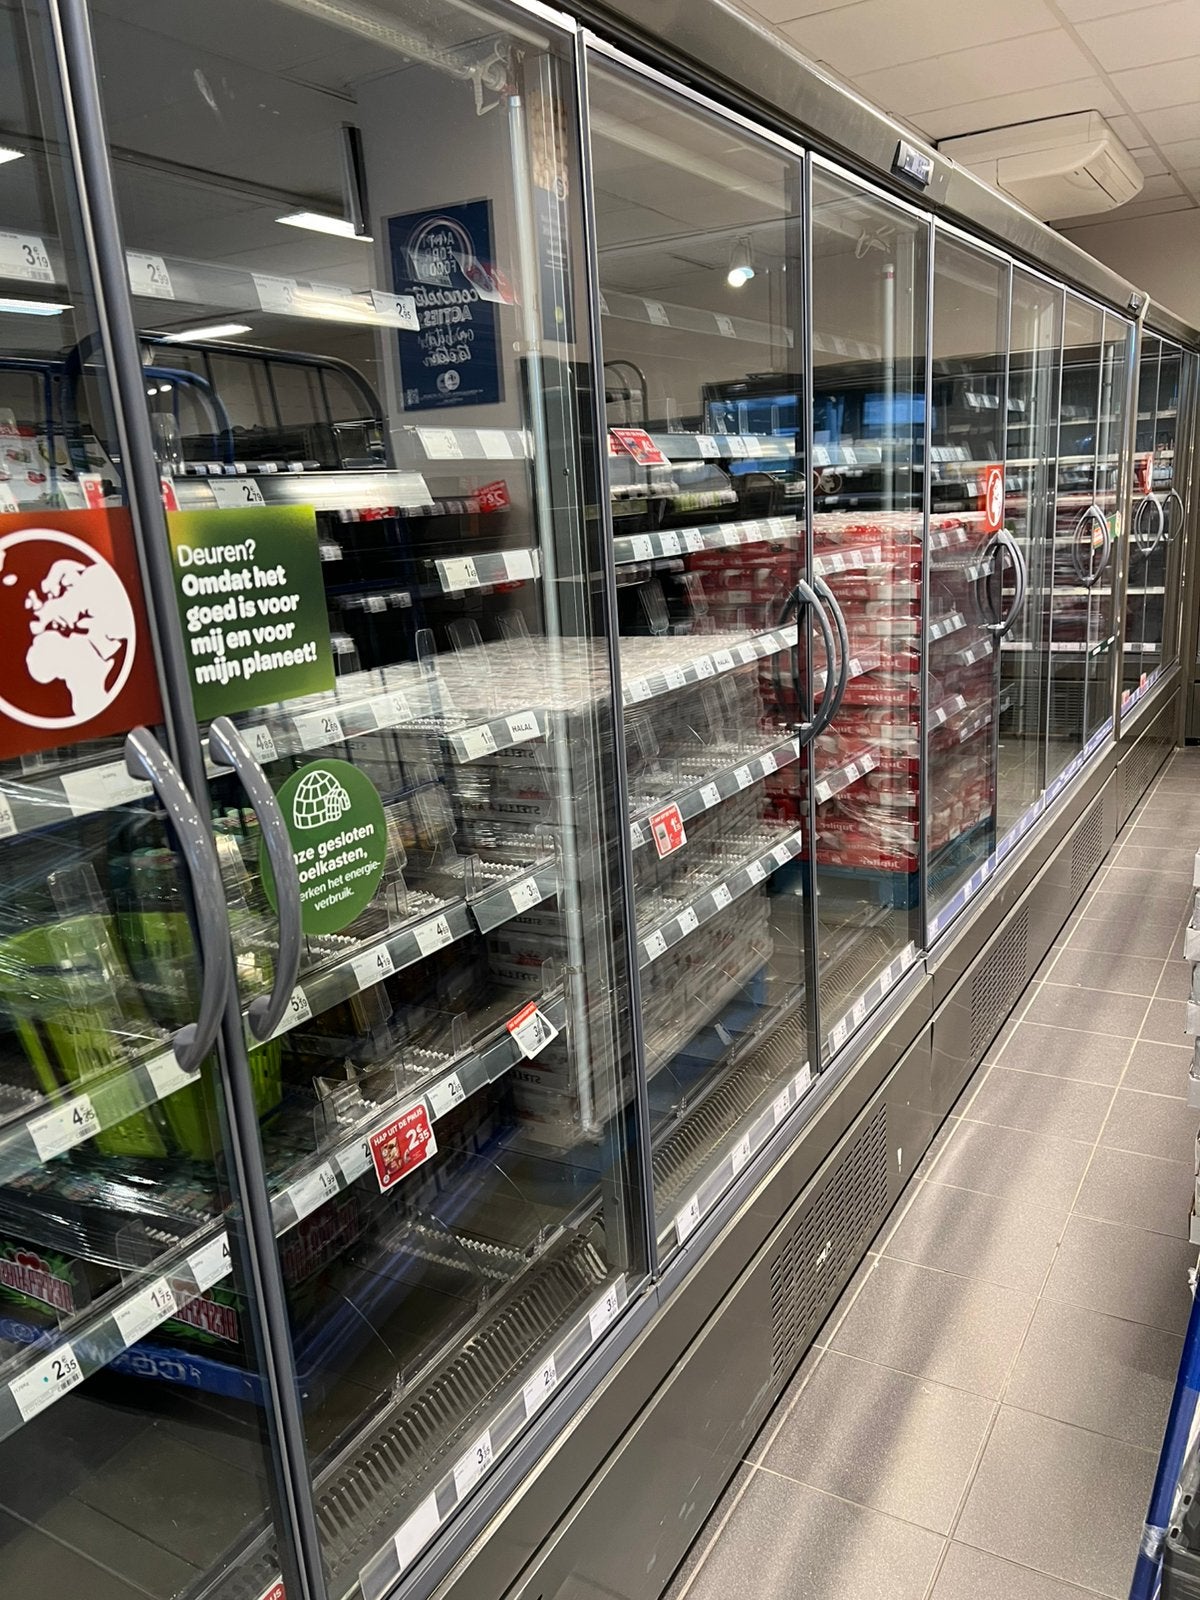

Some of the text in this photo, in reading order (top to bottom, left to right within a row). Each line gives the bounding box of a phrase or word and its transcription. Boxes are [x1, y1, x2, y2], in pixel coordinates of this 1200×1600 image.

[177, 538, 256, 567] Deuren?
[181, 564, 287, 597] Omdat het
[186, 594, 300, 632] goed is voor
[191, 622, 296, 656] mij en voor
[195, 641, 317, 685] mijn planeet!
[511, 723, 532, 733] HALAL
[317, 823, 375, 859] gesloten
[298, 846, 368, 884] oelkasten,
[327, 877, 344, 889] het
[345, 860, 381, 882] energie-
[313, 886, 355, 912] verbruik.
[374, 1131, 388, 1147] HAP
[387, 1124, 399, 1137] UIT
[398, 1120, 407, 1131] DE
